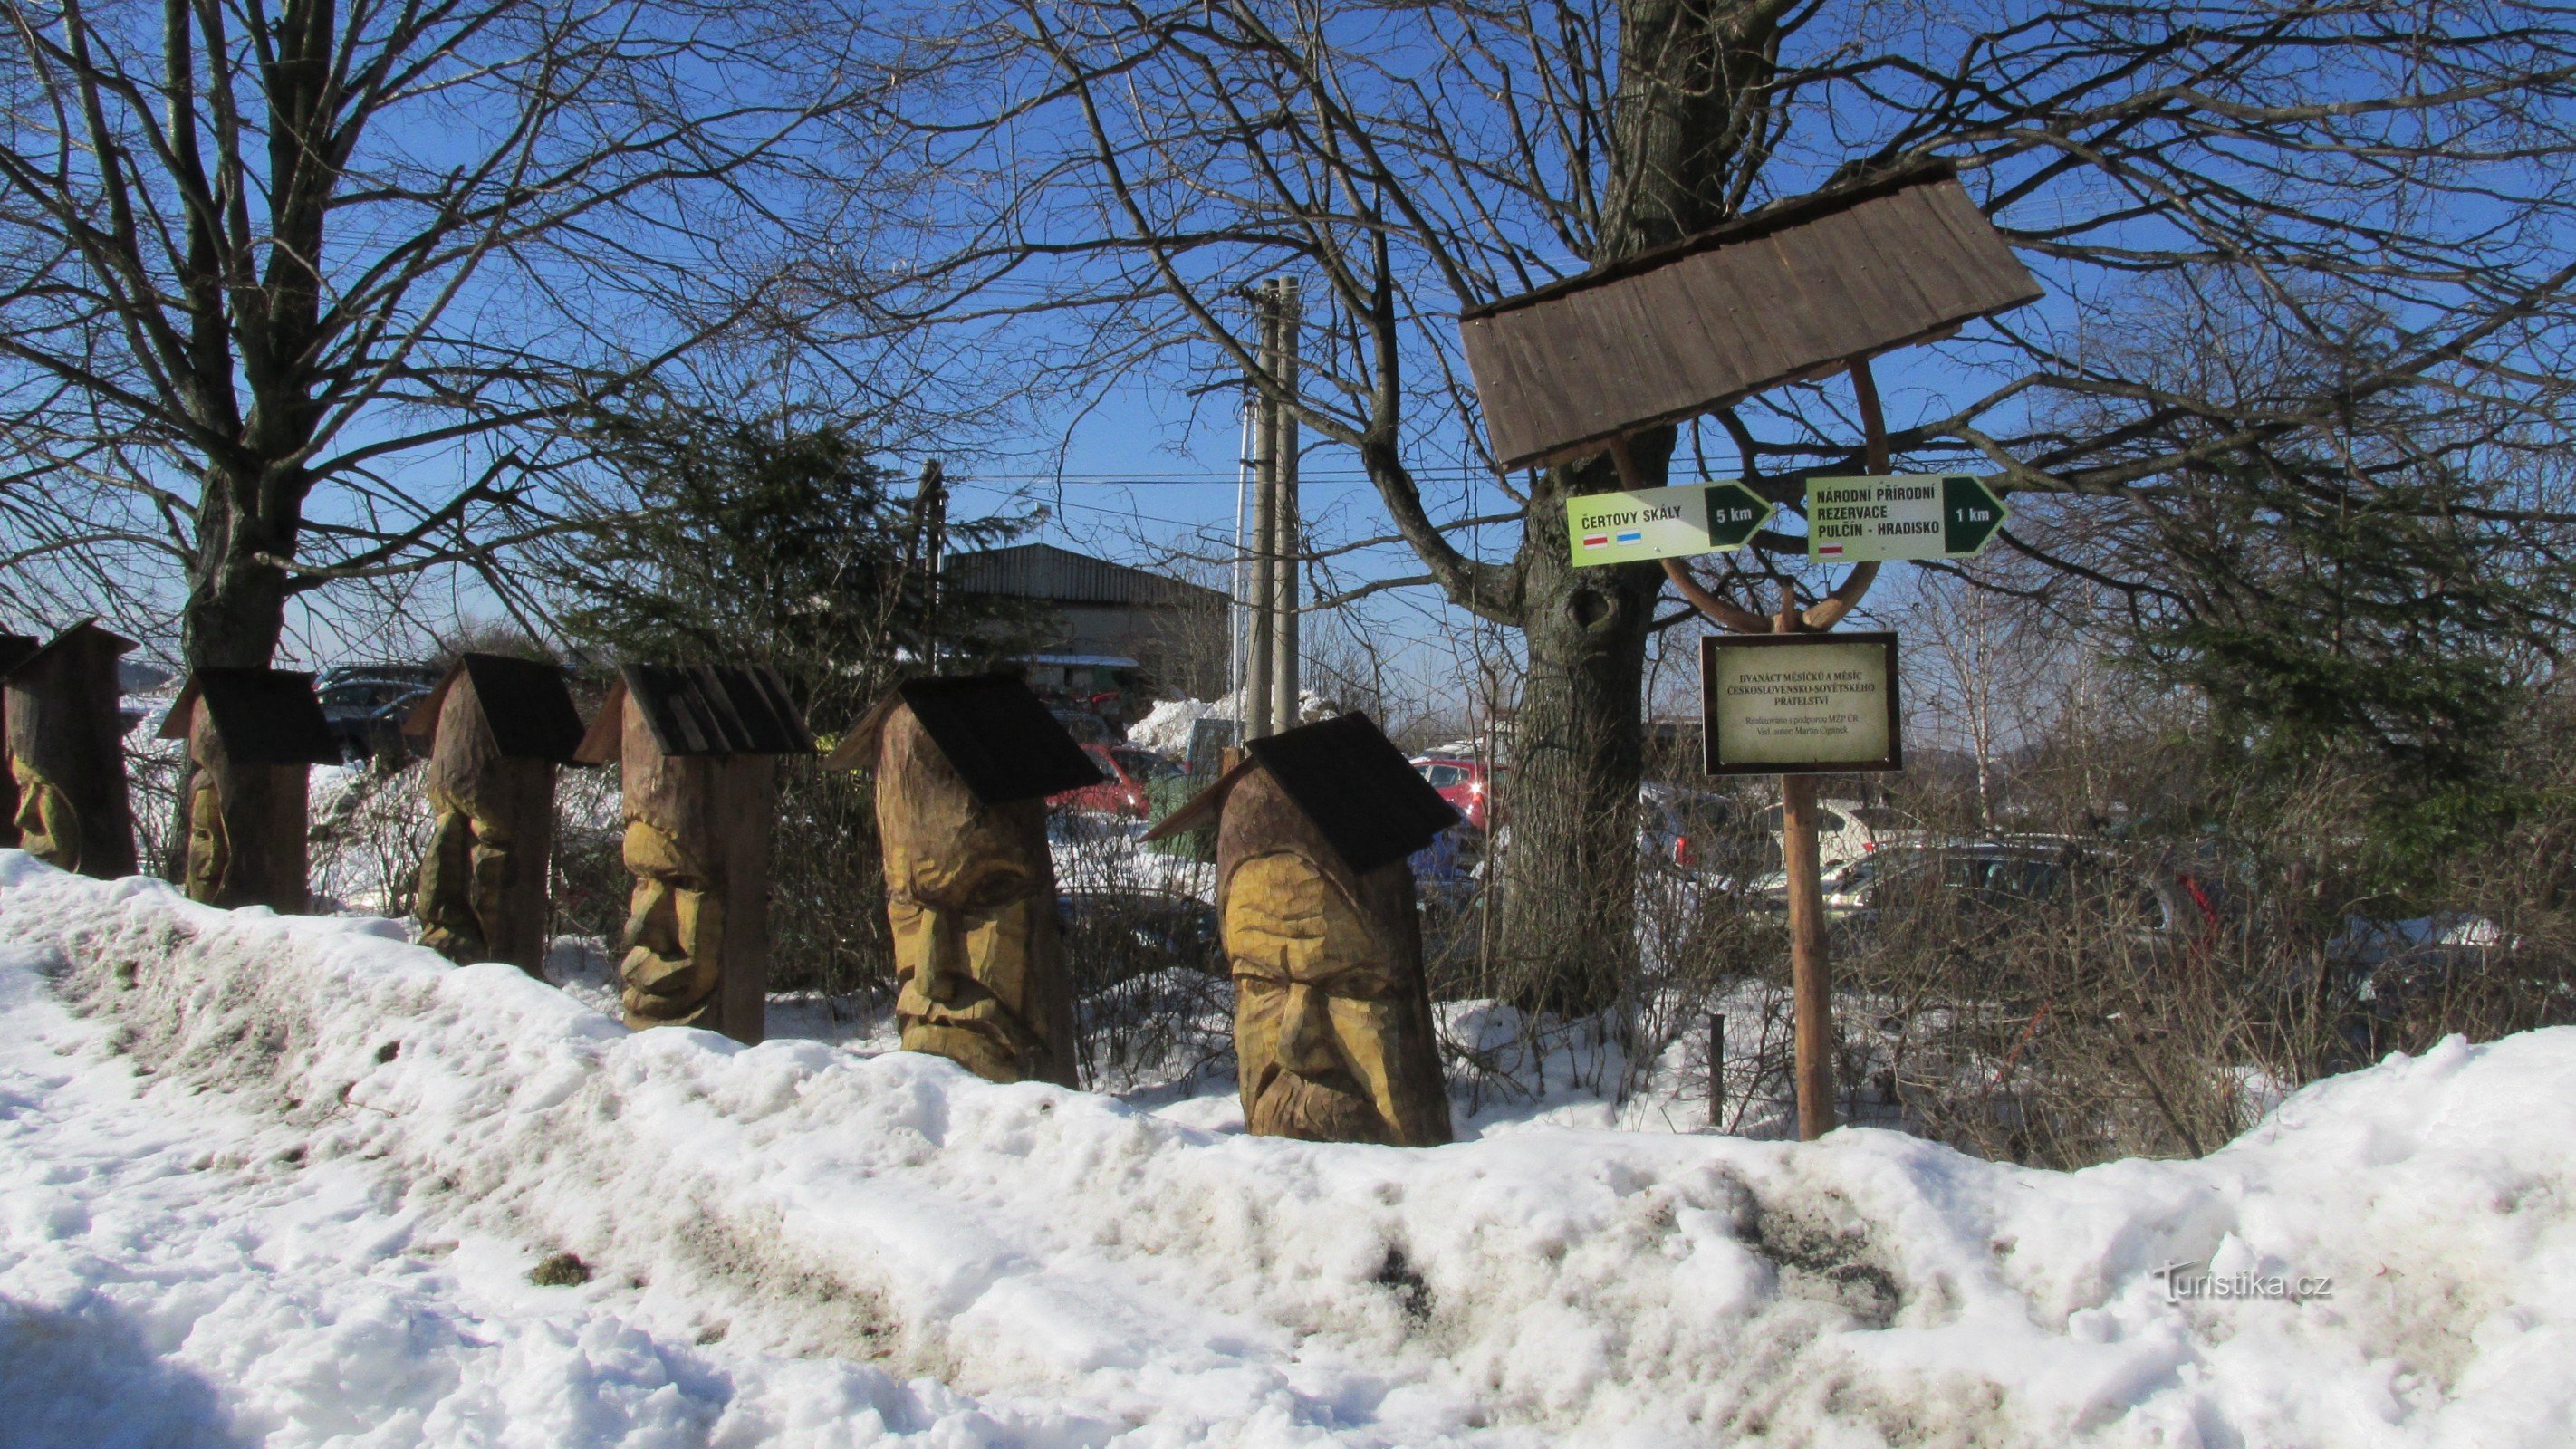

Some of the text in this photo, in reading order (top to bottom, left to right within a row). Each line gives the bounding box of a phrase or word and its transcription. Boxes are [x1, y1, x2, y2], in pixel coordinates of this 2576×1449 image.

[1817, 483, 1935, 504] NÁRODNÍ PŘÍRODNÍ
[1581, 504, 1681, 530] ČERTOVY SKÁLY
[1716, 507, 1752, 523] 5 km
[1818, 505, 1887, 520] REZERVACE
[1956, 507, 1989, 522] 1 km
[1819, 521, 1862, 538] PULČÍN
[1878, 521, 1939, 536] HRADISKO
[1740, 673, 1782, 683] DVANÁCT
[1825, 673, 1831, 681] A
[1834, 670, 1862, 680] MĚSÍC
